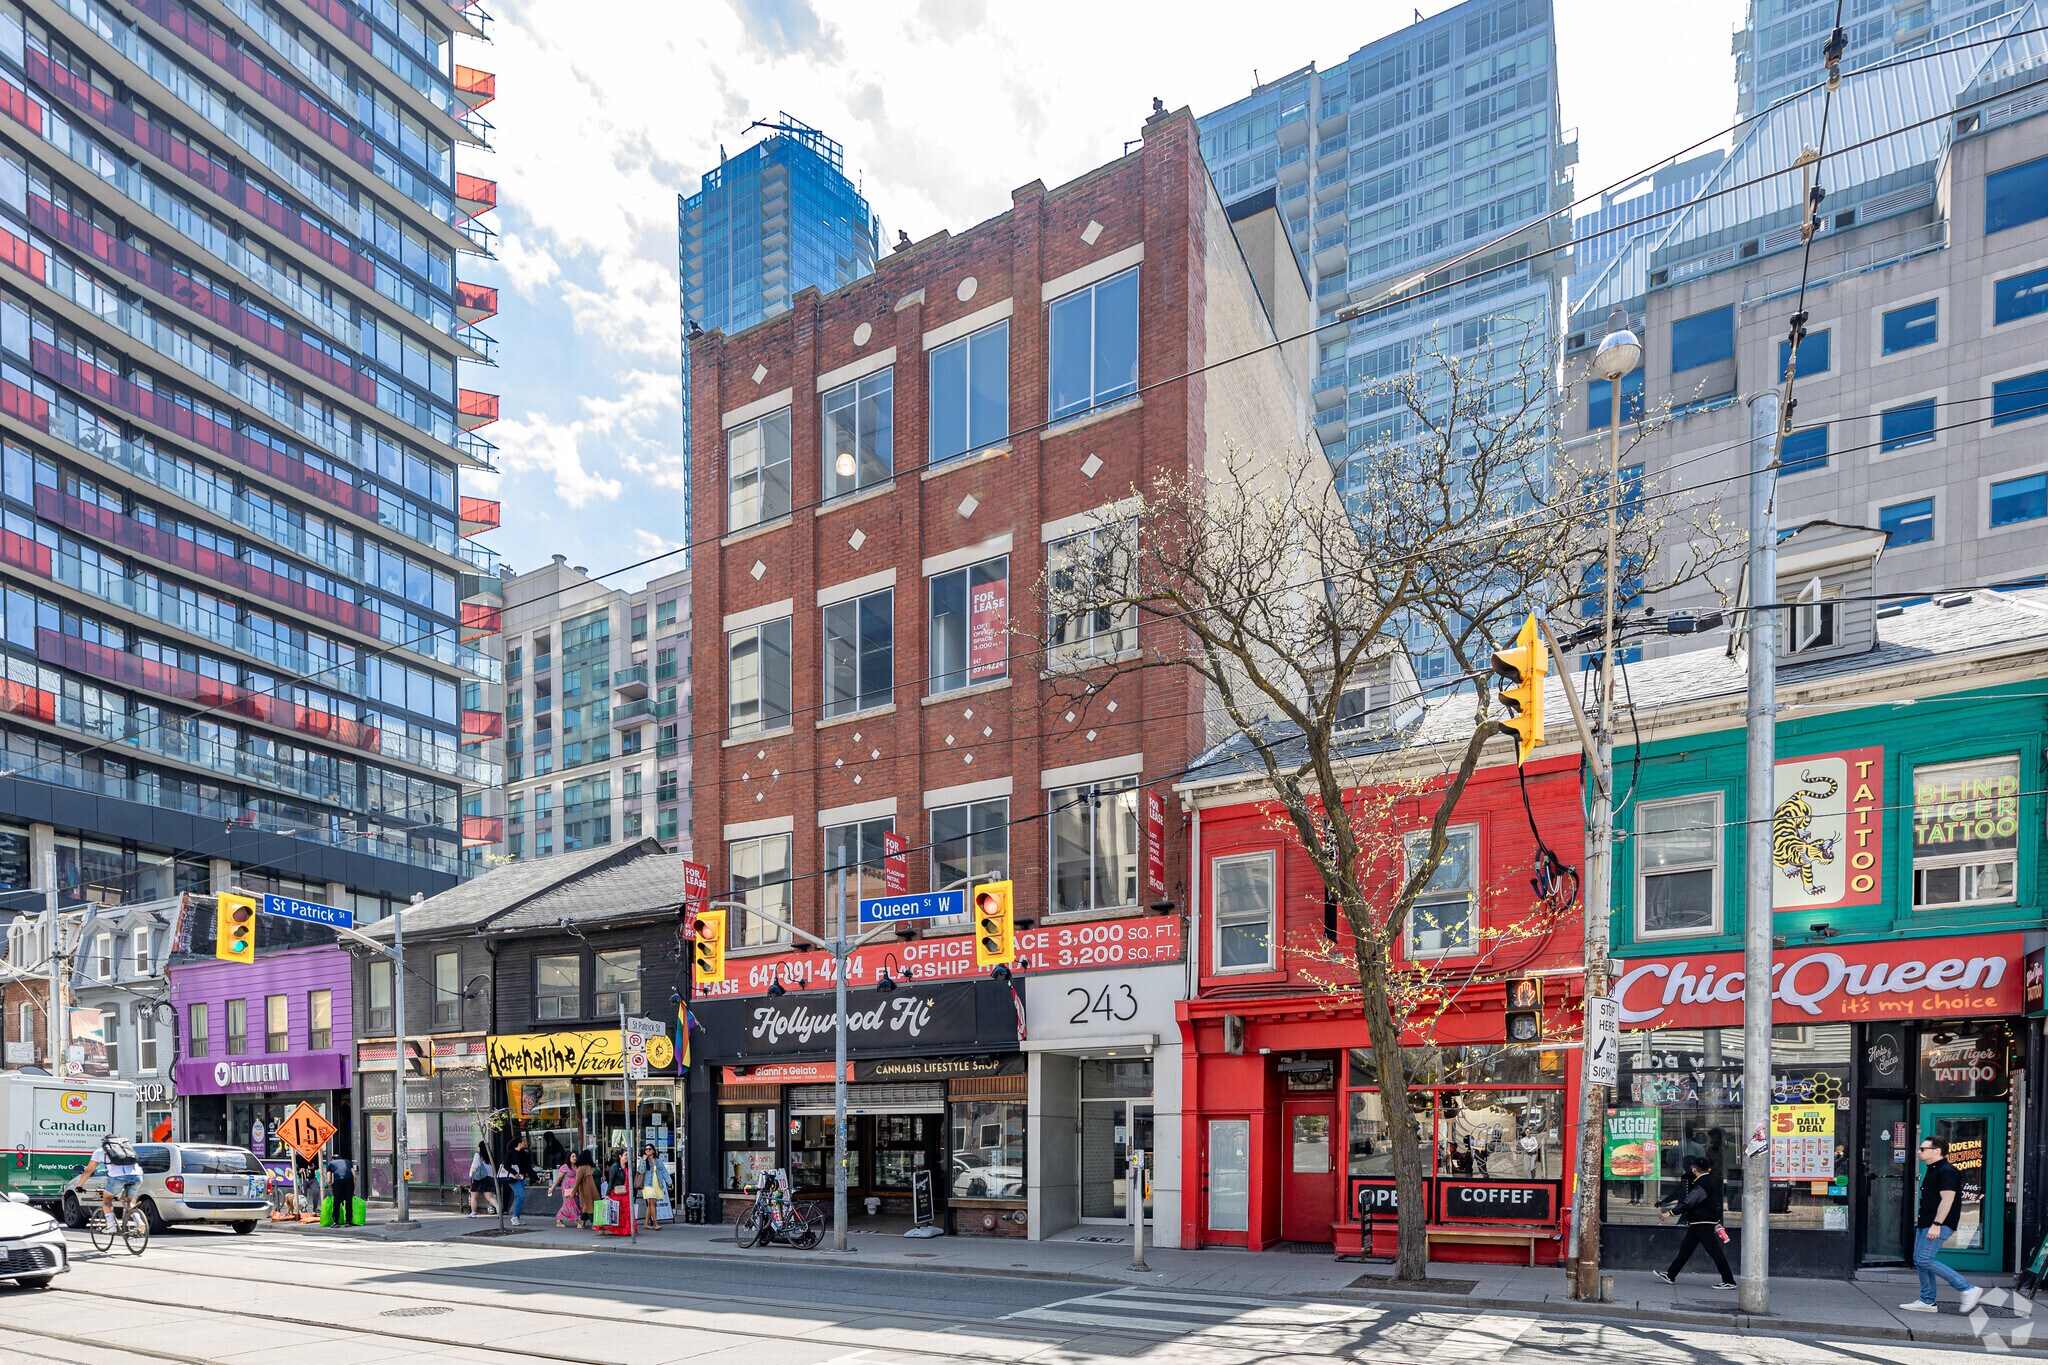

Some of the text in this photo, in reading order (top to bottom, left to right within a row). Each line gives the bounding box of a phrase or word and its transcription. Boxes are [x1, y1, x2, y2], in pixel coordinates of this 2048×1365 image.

[974, 591, 994, 605] FOR
[974, 597, 1005, 614] LEASE
[973, 623, 989, 631] LOFT
[1917, 775, 2018, 805] BLIND
[1149, 797, 1159, 813] FOR
[1916, 797, 2017, 825] TIGER
[1149, 808, 1164, 826] LEASE
[1850, 760, 1875, 893] TATTOO
[1914, 816, 2018, 845] TATTOO
[885, 838, 899, 851] FOR
[886, 848, 906, 863] LEASE
[685, 867, 700, 879] FOR
[686, 876, 707, 889] LEASE
[273, 898, 346, 922] St Patrick St
[871, 897, 950, 920] Queen St W
[903, 924, 1177, 962] OFFICE ACE 3,000 SQ. FT.
[875, 960, 970, 982] FLAGSHIP
[1058, 944, 1124, 966] 3,200
[1128, 948, 1152, 960] SQ.
[1155, 945, 1176, 958] FT.
[696, 979, 739, 997] LEASE
[1067, 984, 1138, 1024] 243
[1600, 1004, 1615, 1017] STOP
[1841, 994, 1998, 1014] it's my choice
[632, 1021, 661, 1032] St Patrick St
[752, 996, 933, 1044] Hollywod Hi
[1599, 1020, 1615, 1033] HERE
[1610, 1037, 1616, 1049] ON
[488, 1037, 576, 1076] Adrenaline
[1606, 1052, 1617, 1064] RED
[1929, 1048, 1995, 1067] Blind Tiger
[755, 1066, 817, 1076] Gianni's Gelato
[875, 1063, 921, 1075] CANNABIS
[924, 1061, 969, 1073] LIFESTYLE
[1932, 1066, 1994, 1082] TATTOO
[136, 1084, 163, 1102] SHOP
[1773, 1084, 1813, 1097] OPEN
[39, 1118, 106, 1132] Canadian
[1608, 1117, 1657, 1134] VEGGIE
[1772, 1113, 1794, 1132] $5
[1948, 1140, 1982, 1153] ODERN
[1953, 1159, 1982, 1172] TOOING
[1358, 1189, 1398, 1207] OPE
[1961, 1190, 1985, 1204] OME!
